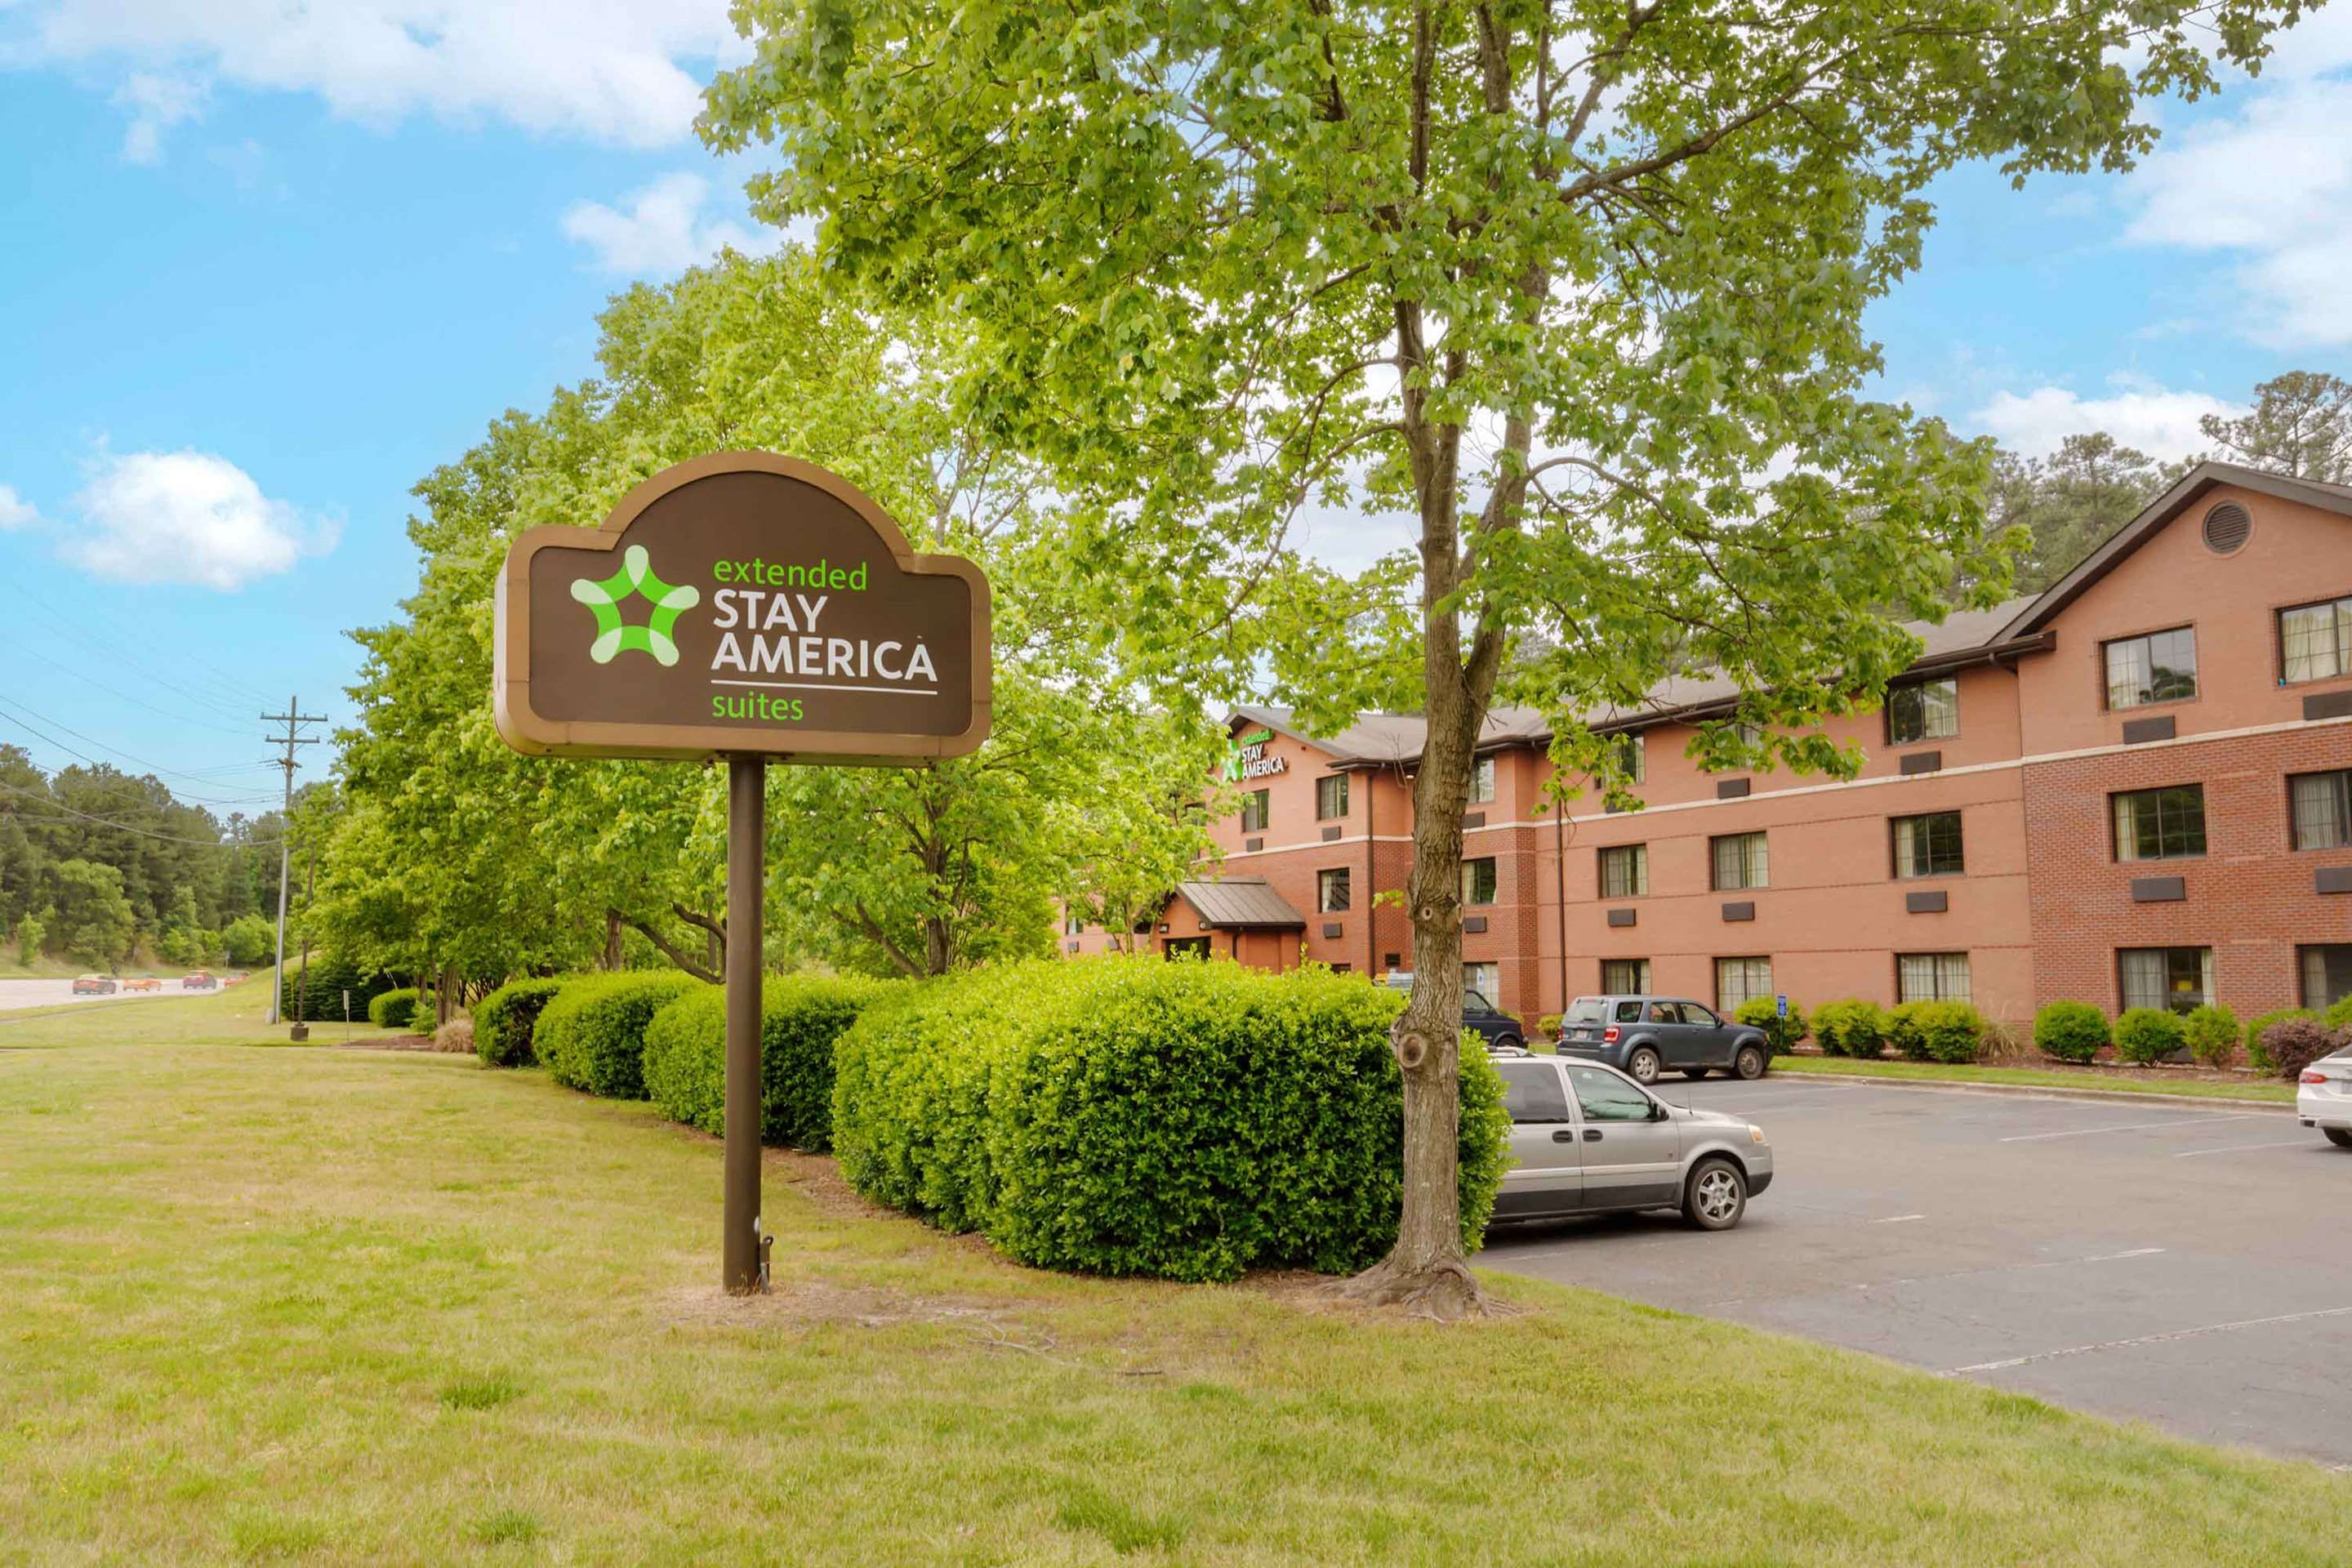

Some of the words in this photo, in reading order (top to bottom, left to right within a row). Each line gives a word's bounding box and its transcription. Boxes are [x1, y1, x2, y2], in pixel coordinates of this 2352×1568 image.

[713, 559, 867, 591] extended
[713, 588, 828, 633] STAY
[710, 632, 938, 682] AMERICA
[713, 692, 804, 721] suites
[1241, 743, 1263, 763] STAY
[1241, 756, 1284, 778] AMERICA
